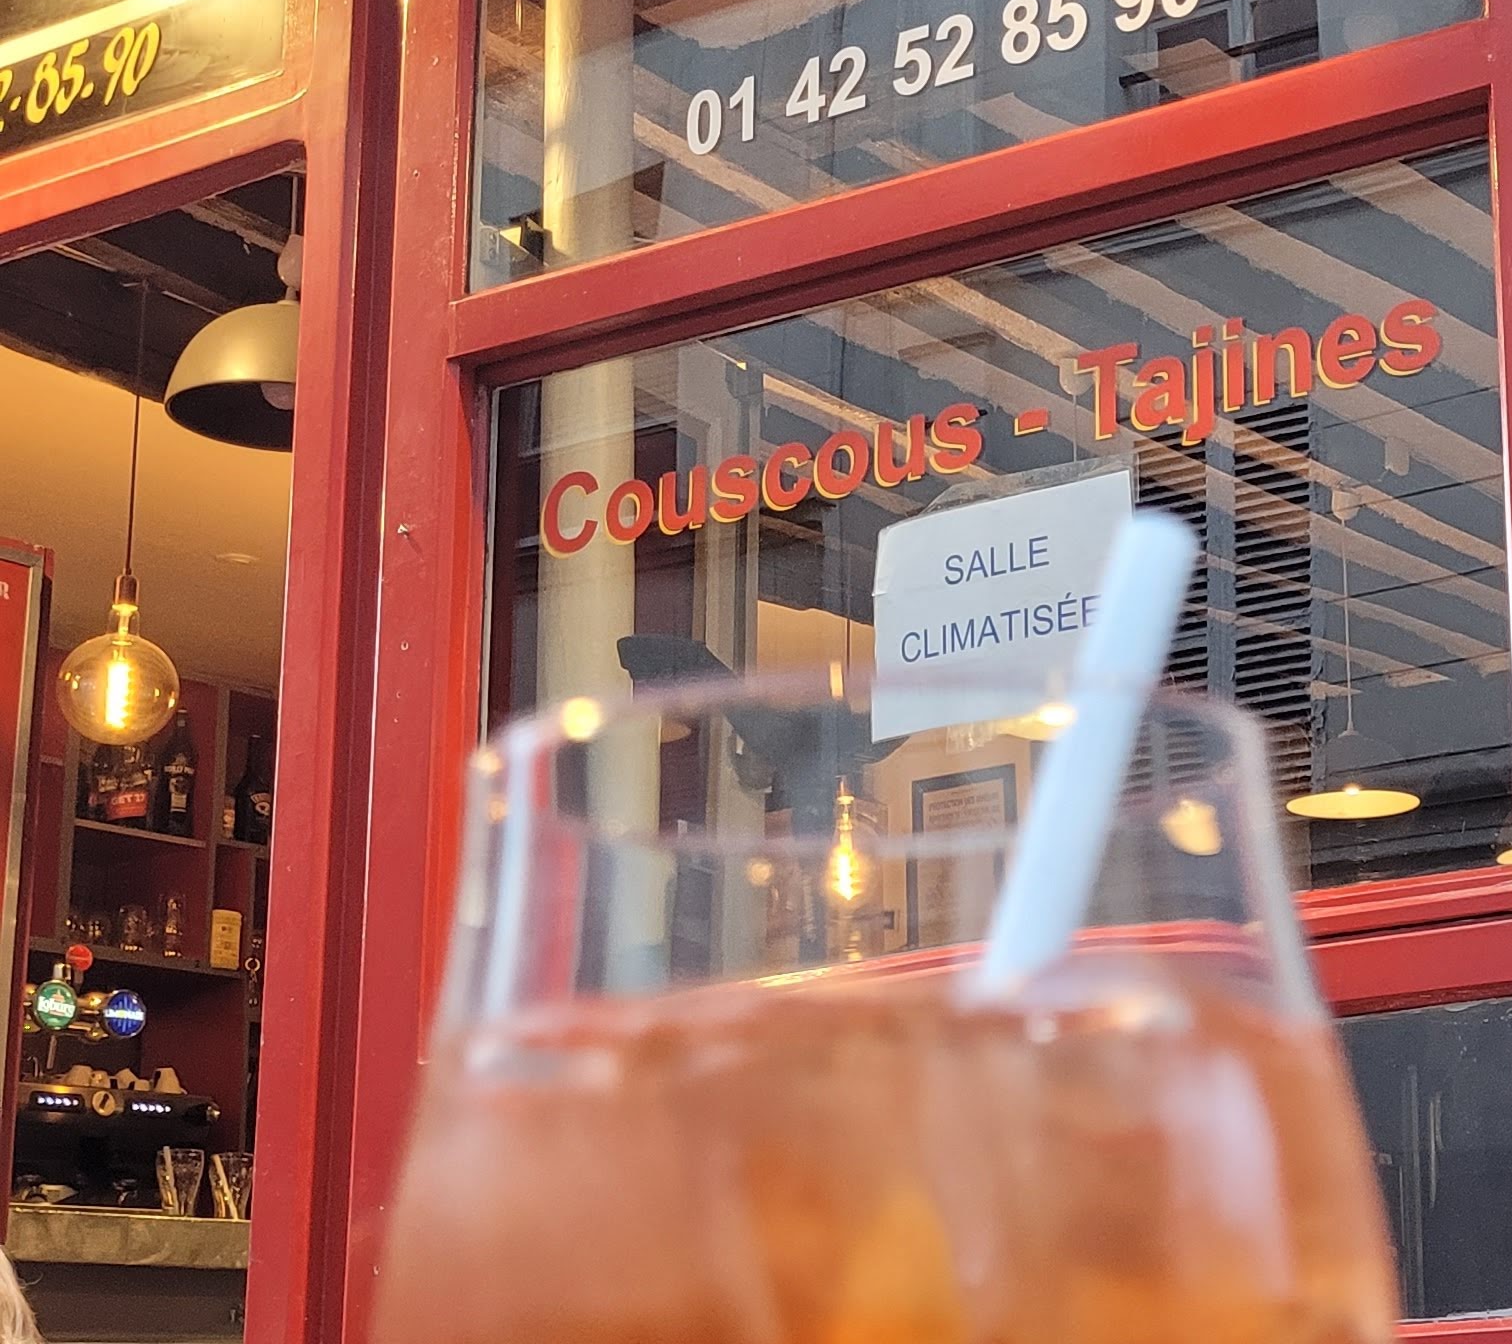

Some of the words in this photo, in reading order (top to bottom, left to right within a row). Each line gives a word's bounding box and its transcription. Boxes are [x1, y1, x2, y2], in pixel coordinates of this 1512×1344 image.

[686, 75, 755, 156] 01
[785, 46, 867, 124] 42
[892, 13, 974, 96] 52
[541, 402, 983, 558] Couscous
[1079, 298, 1443, 446] Tajines
[944, 535, 1050, 585] SALLE
[901, 592, 1103, 663] CLIMATISÉE
